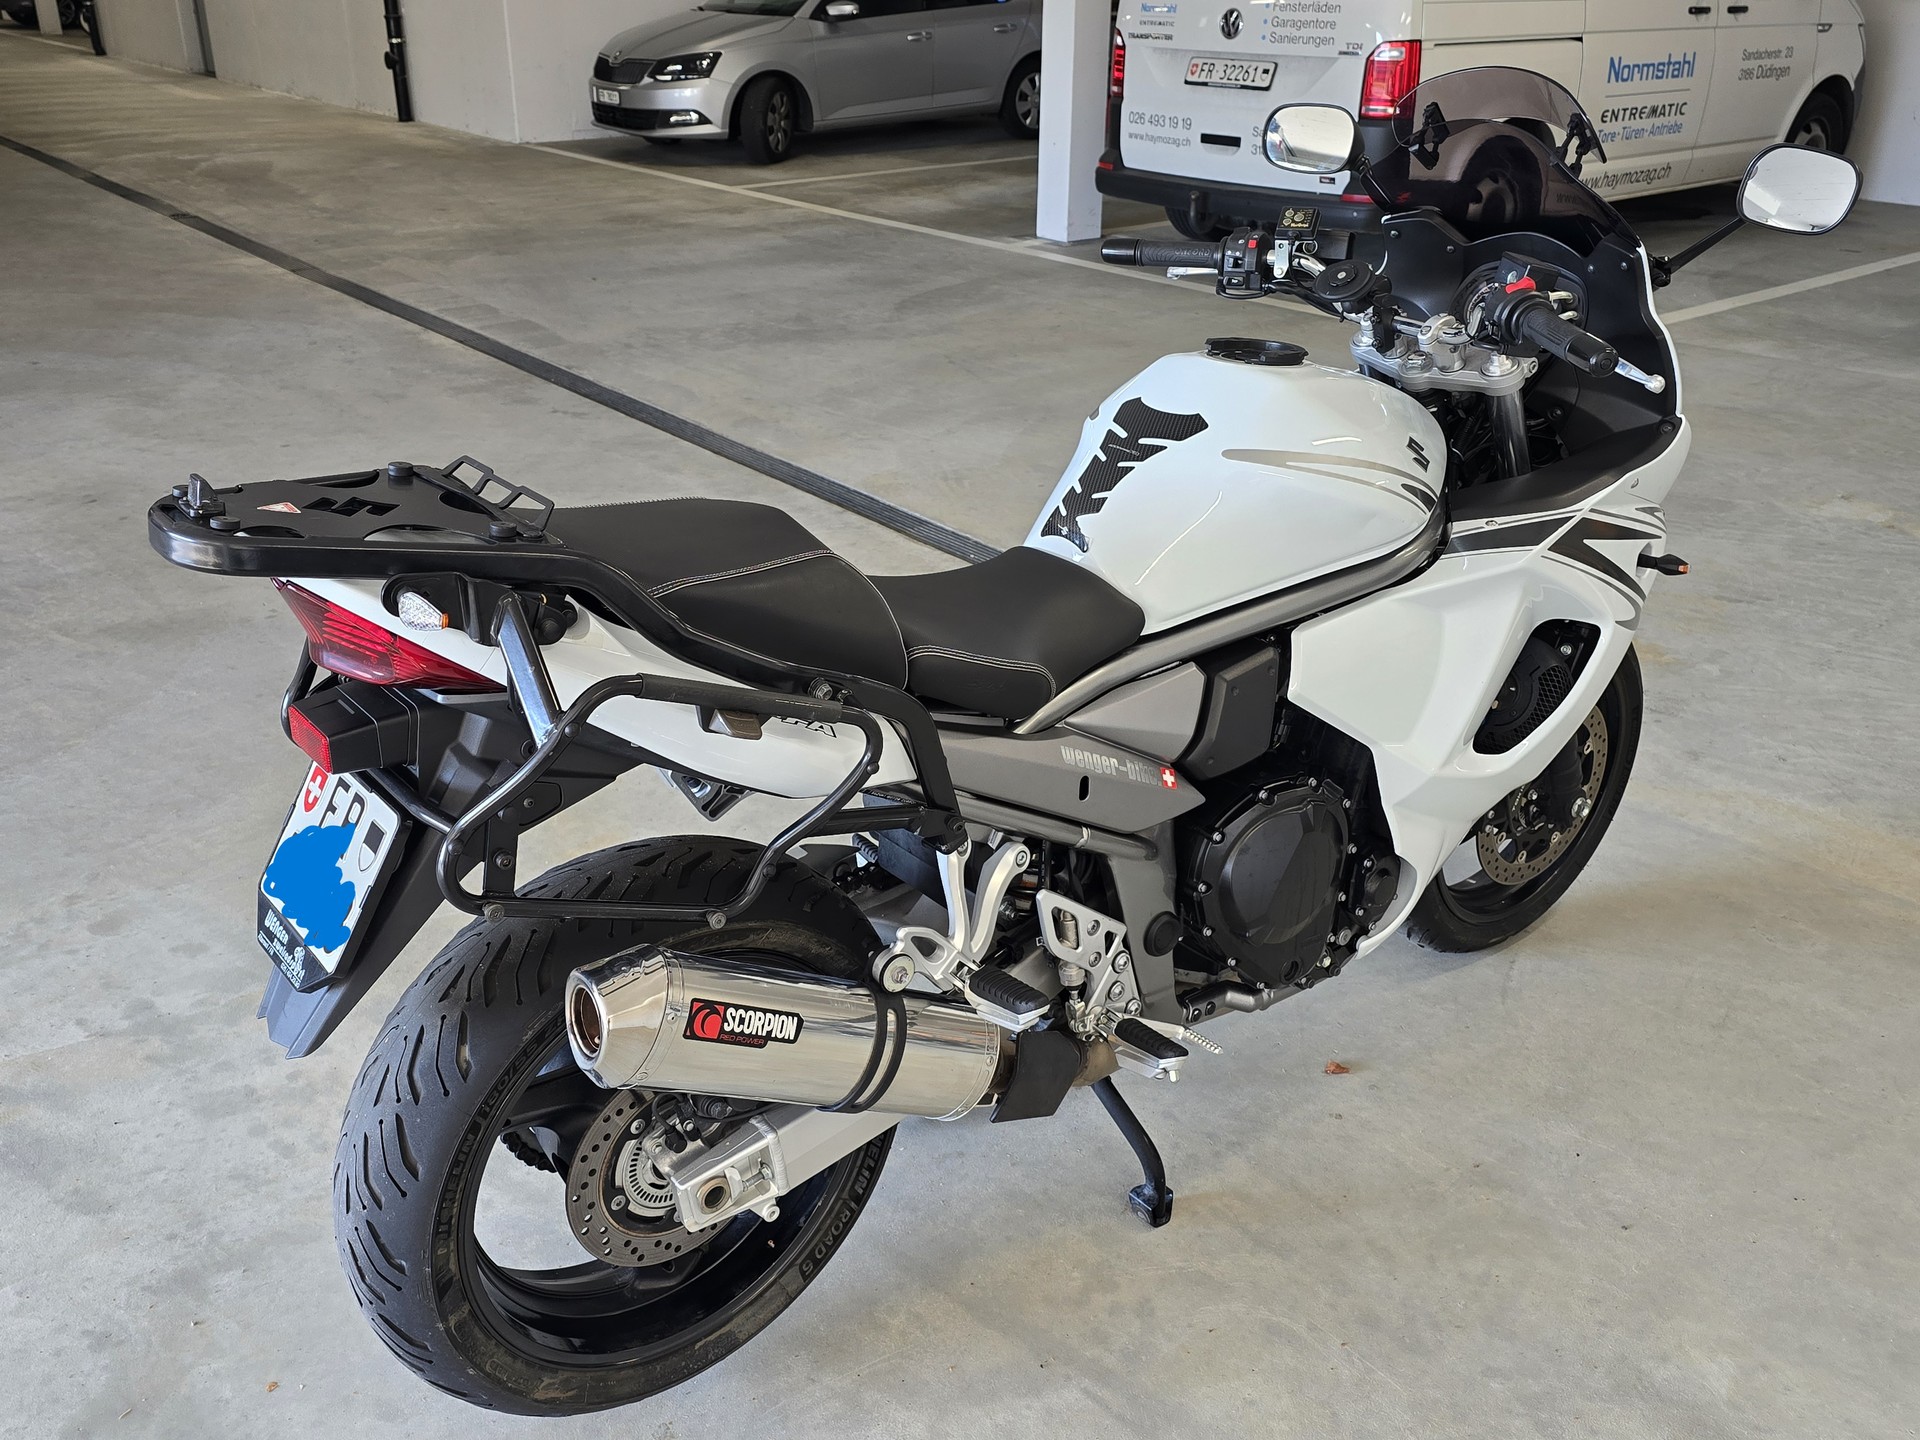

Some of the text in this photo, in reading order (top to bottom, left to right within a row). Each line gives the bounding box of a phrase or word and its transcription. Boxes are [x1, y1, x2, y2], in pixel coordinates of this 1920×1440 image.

[1271, 16, 1336, 31] Garagentore
[1269, 31, 1335, 48] Sanierungen
[1198, 62, 1258, 82] FR 32261
[1607, 51, 1696, 83] Normstahl
[1756, 64, 1790, 81] Düdingen
[1128, 111, 1192, 131] 026 493 19 19
[723, 1006, 798, 1041] SCORPION
[720, 1033, 765, 1045] RED POWER
[815, 1207, 850, 1259] ROAD
